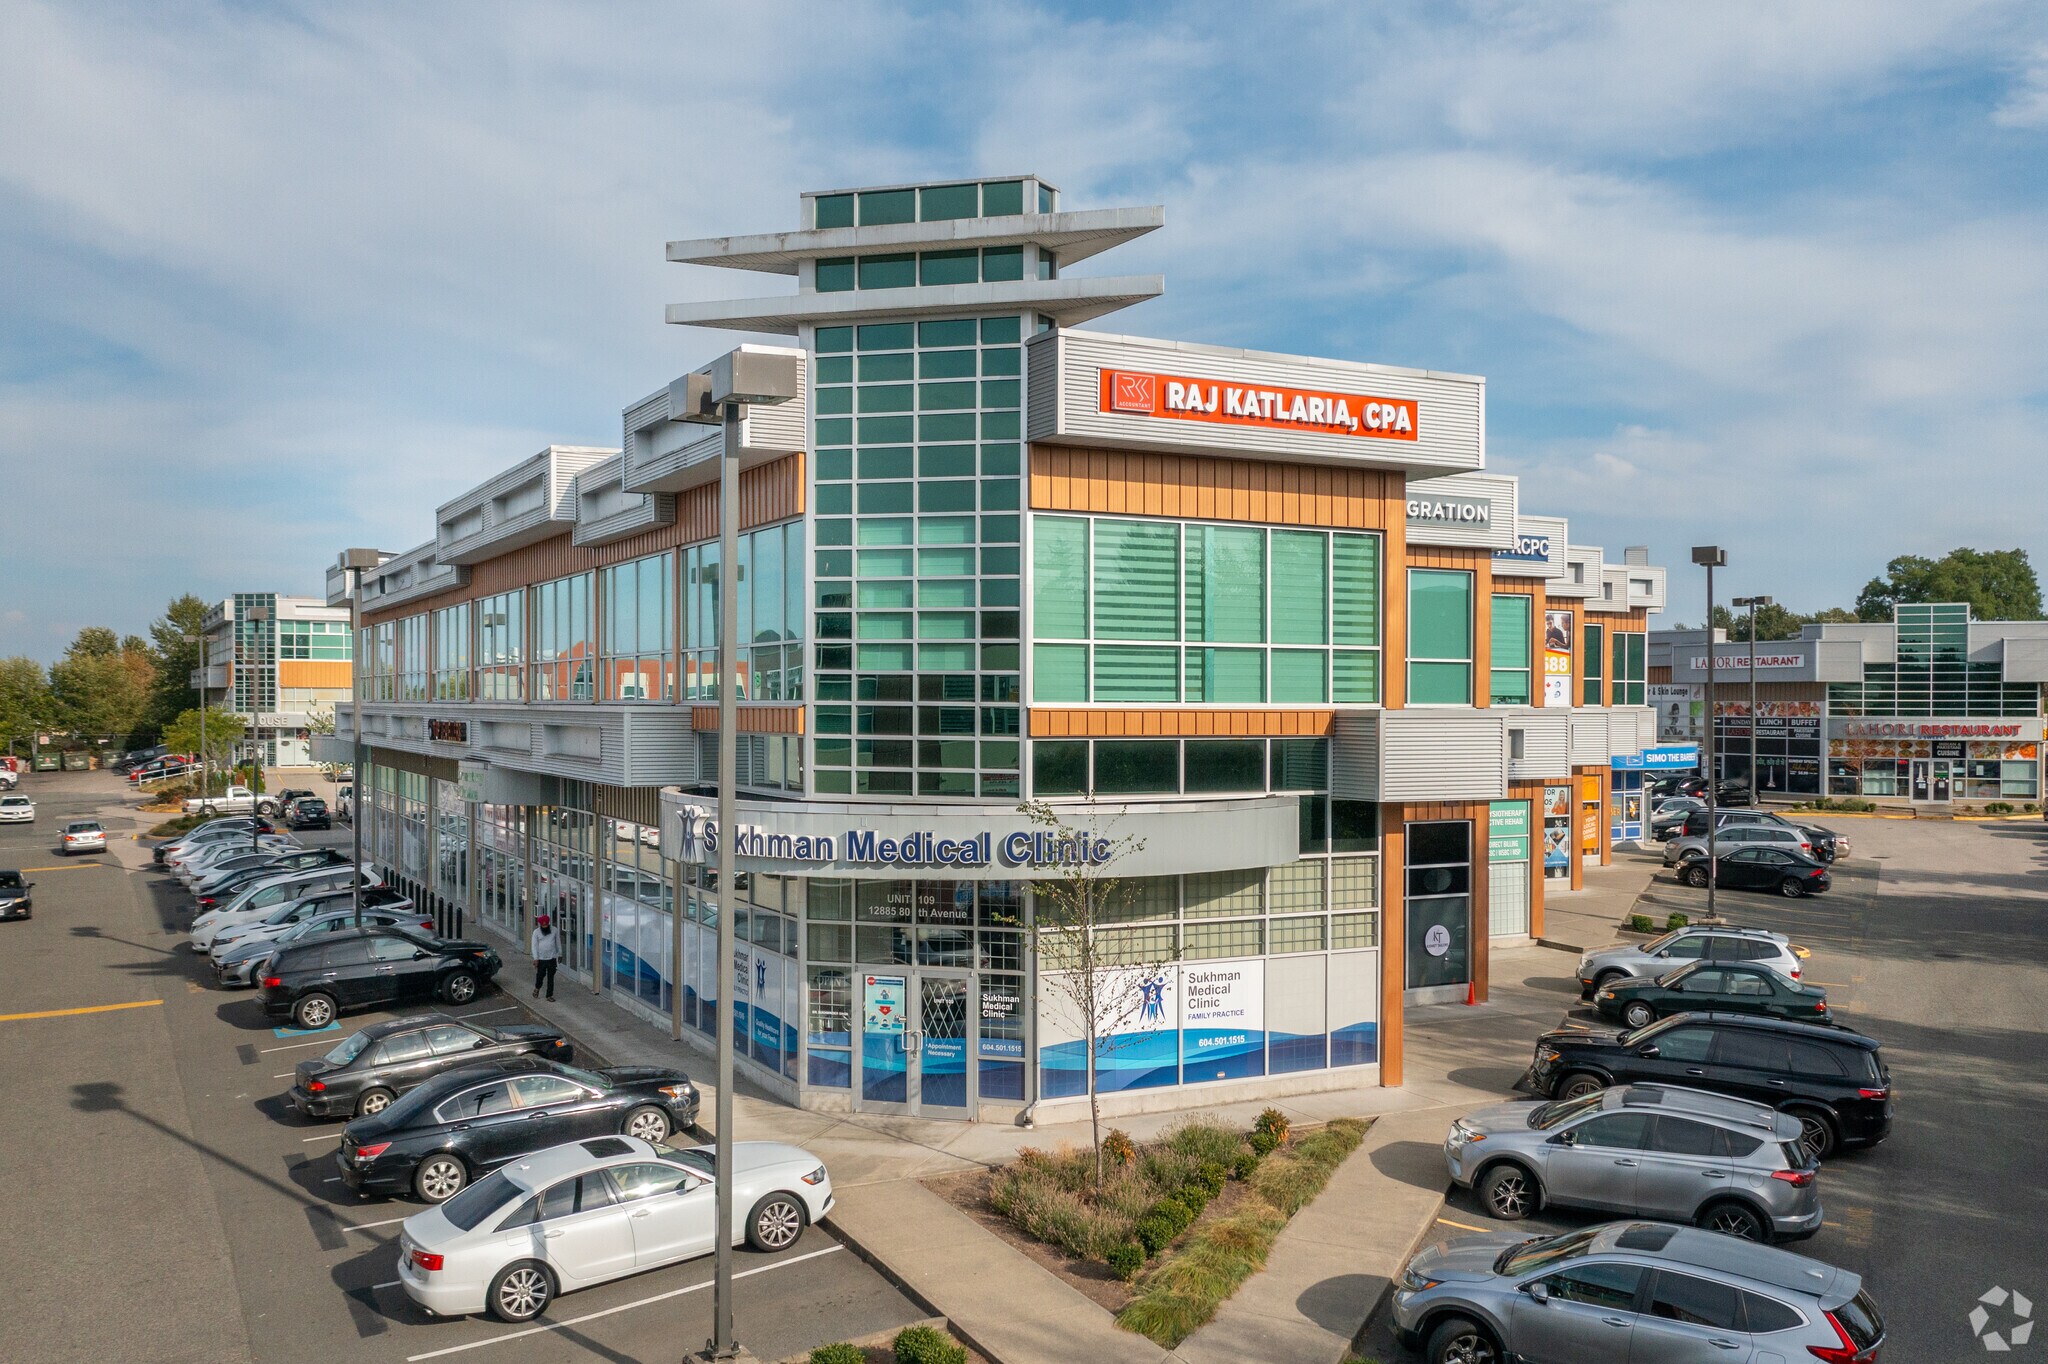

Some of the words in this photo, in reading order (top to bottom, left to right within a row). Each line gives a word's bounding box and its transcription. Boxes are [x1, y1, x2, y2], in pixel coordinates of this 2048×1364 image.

[1119, 401, 1151, 409] ACCOUNTANT
[1168, 381, 1218, 413] RAJ
[1226, 387, 1358, 431] KATLARIA,
[1365, 402, 1412, 431] CPA
[1406, 500, 1489, 521] GRATION
[1695, 657, 1736, 668] LAORI
[1737, 656, 1800, 667] RETAURANT
[1670, 685, 1689, 697] Lounge
[1920, 725, 2022, 737] RESTAURANT
[1646, 754, 1667, 762] SIMO
[1667, 753, 1680, 762] THE
[703, 821, 834, 860] Skhman
[846, 831, 992, 864] Medical
[1004, 831, 1112, 864] Clinic
[887, 895, 911, 904] UNIT
[918, 895, 935, 905] 109
[868, 906, 897, 916] 12885
[899, 907, 911, 917] 80
[931, 909, 967, 919] Avenue
[1188, 971, 1241, 984] Sukhman
[1188, 983, 1231, 997] Medical
[982, 993, 1020, 1003] Sukhman
[1188, 997, 1220, 1009] Clinic
[982, 1002, 1013, 1011] Medical
[982, 1010, 1006, 1018] Clinic
[1188, 1012, 1211, 1020] FAMILY
[1212, 1009, 1245, 1018] PRACTICE
[1198, 1034, 1246, 1047] 604.501.1515
[928, 1043, 961, 1051] Appointment
[982, 1043, 1022, 1053] 604.501.1515
[927, 1050, 955, 1058] Necessary
